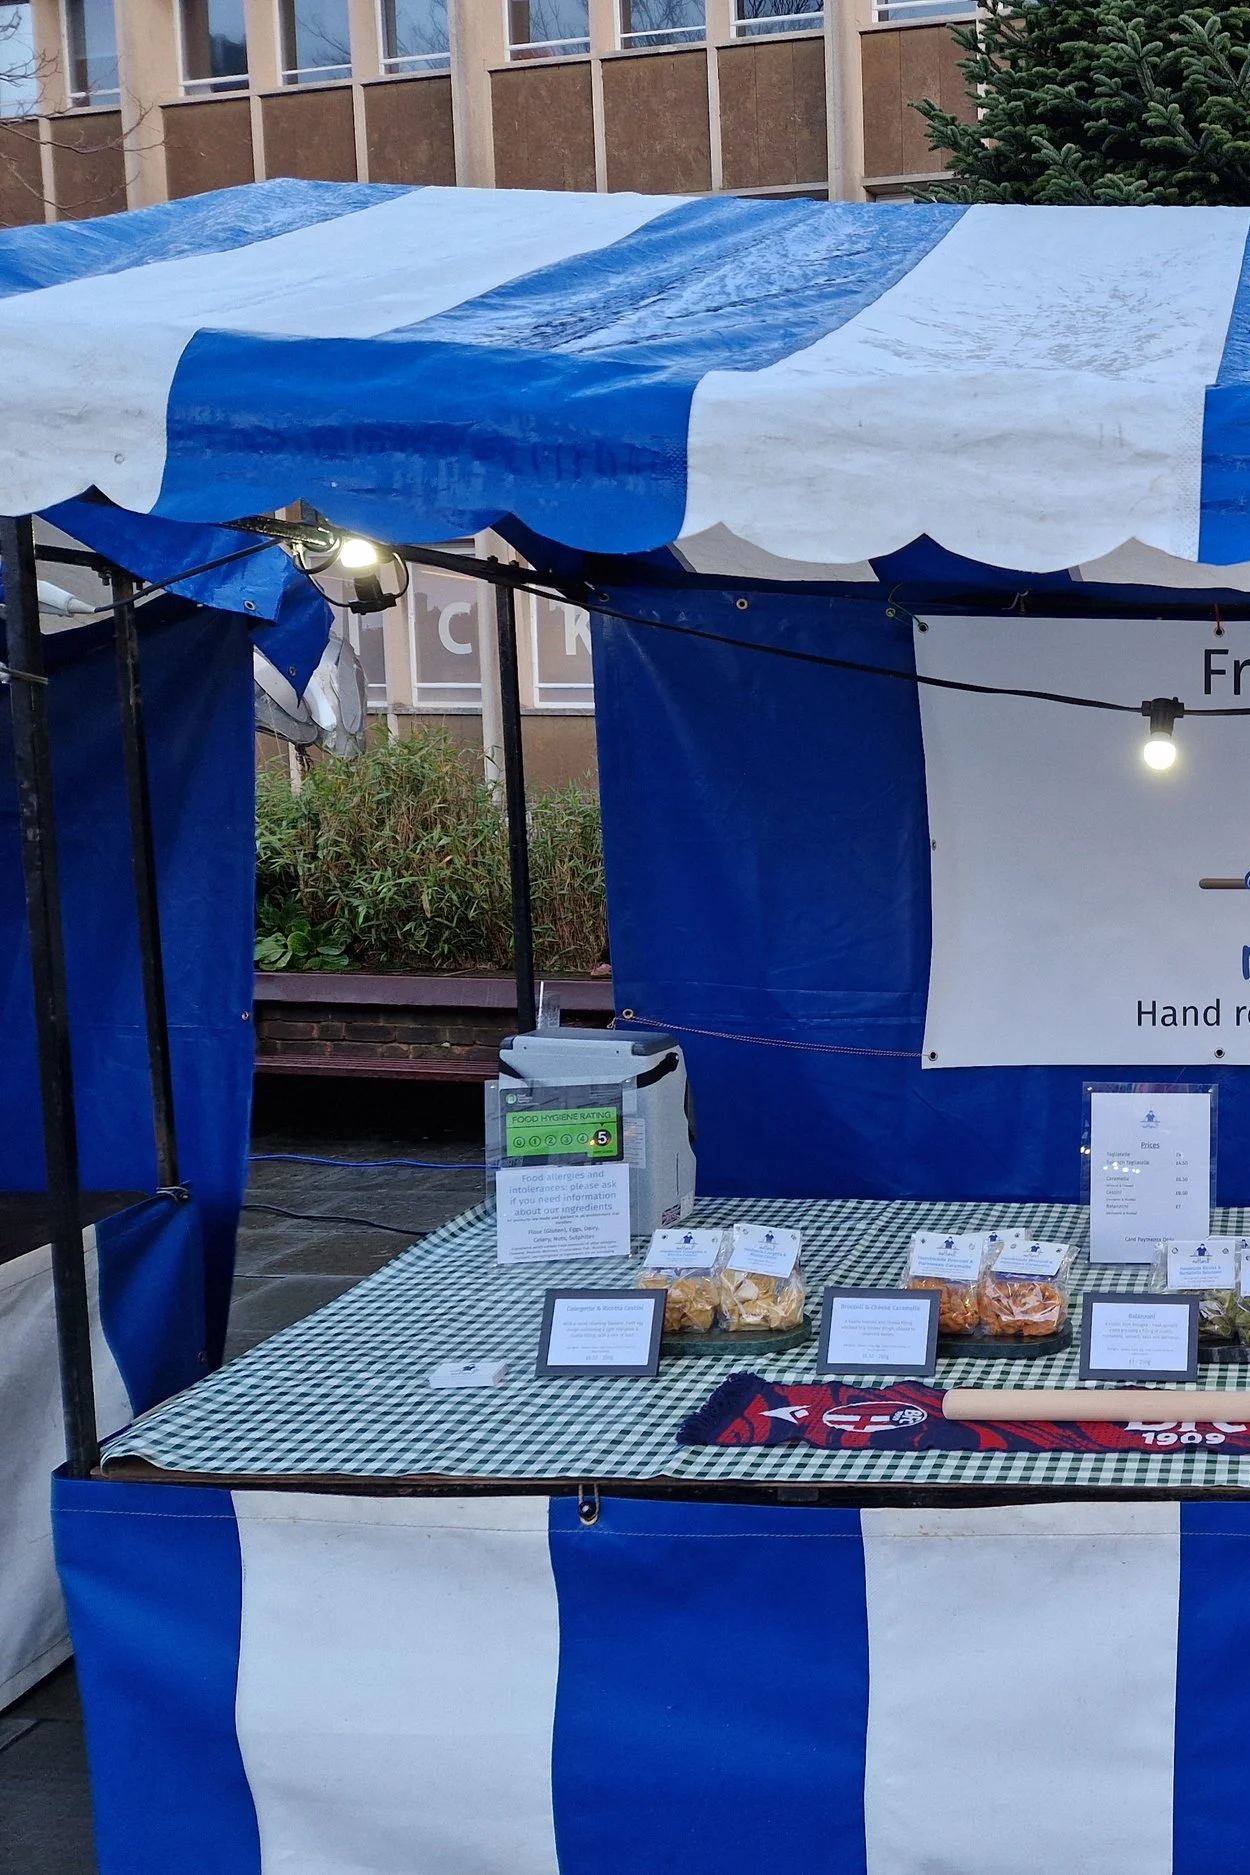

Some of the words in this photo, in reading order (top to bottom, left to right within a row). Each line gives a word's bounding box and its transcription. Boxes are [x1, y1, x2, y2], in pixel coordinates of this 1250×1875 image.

[1136, 1000, 1221, 1028] Hand
[541, 1113, 578, 1122] HYGIENE
[580, 1111, 611, 1119] RATING
[598, 1131, 608, 1144] 5
[546, 1172, 584, 1182] allergies
[570, 1182, 599, 1192] please
[602, 1180, 617, 1188] ask
[519, 1197, 535, 1206] you
[538, 1195, 560, 1203] need
[563, 1192, 616, 1202] information
[515, 1208, 541, 1216] about
[562, 1203, 612, 1214] ingredients
[1142, 1433, 1225, 1446] 1909
